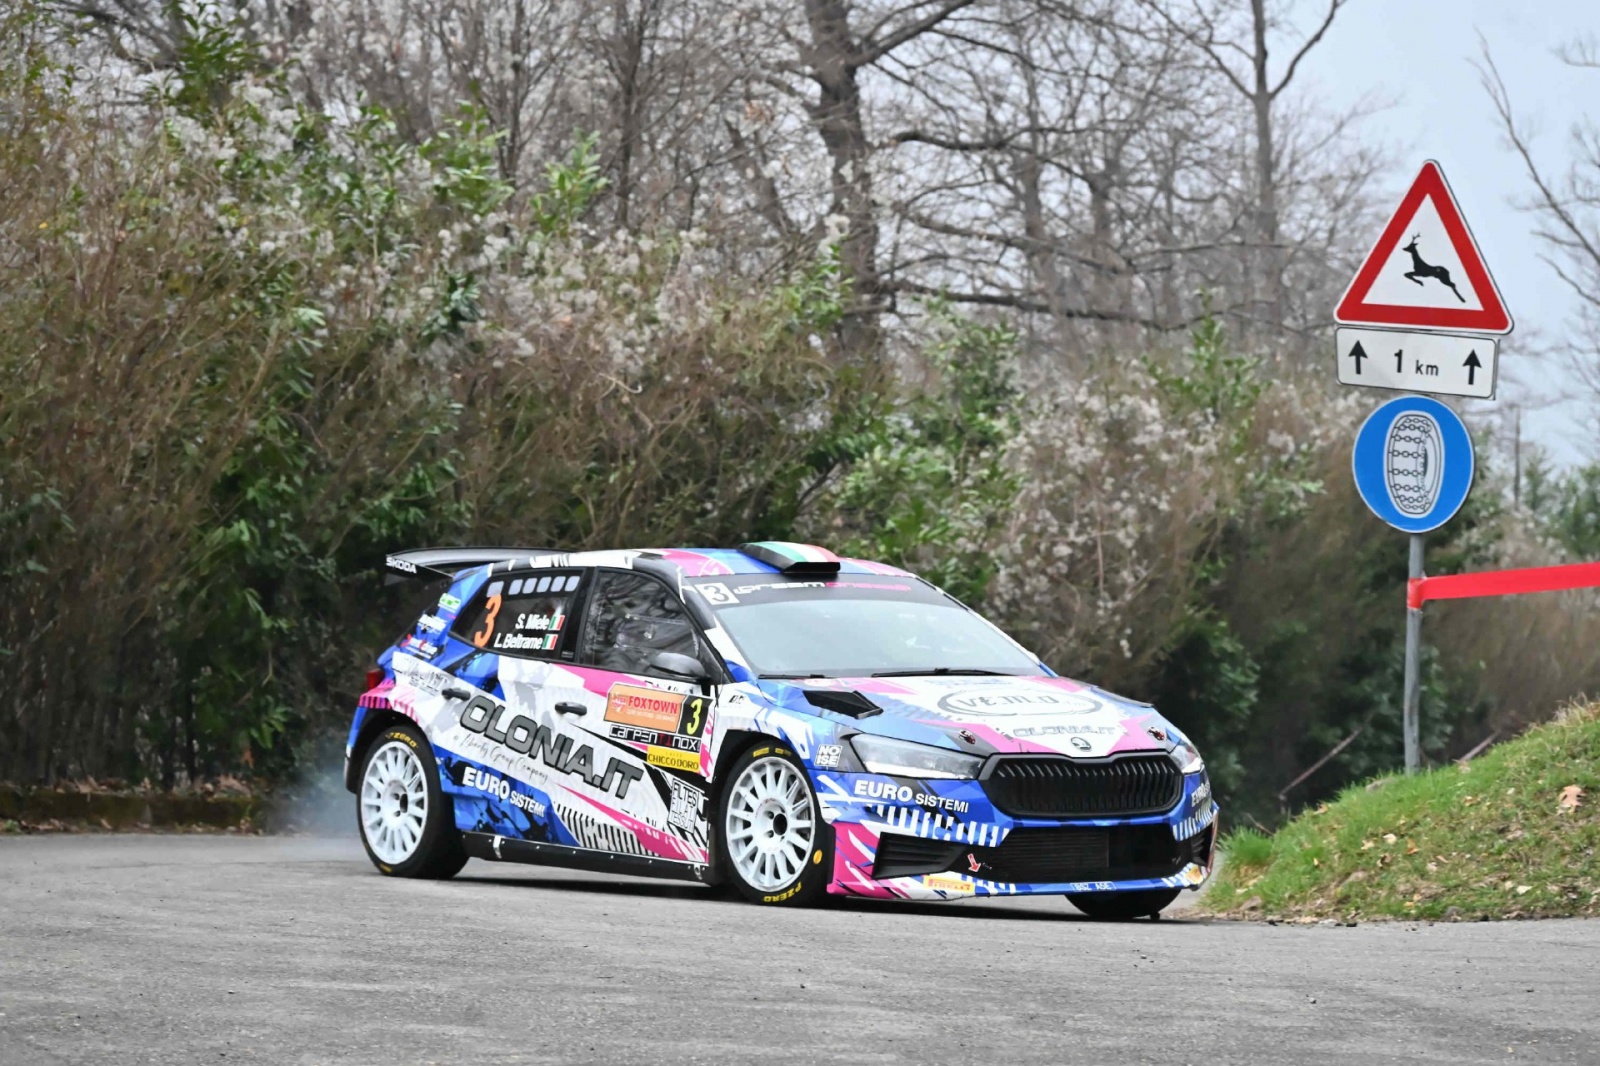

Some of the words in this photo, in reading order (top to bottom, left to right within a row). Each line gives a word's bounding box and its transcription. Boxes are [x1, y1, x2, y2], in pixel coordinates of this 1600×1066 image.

[1394, 349, 1403, 373] 1
[1415, 359, 1439, 376] km
[703, 585, 730, 602] 3
[474, 593, 502, 648] 3
[525, 613, 550, 630] Miele
[502, 633, 544, 649] Beltrame
[628, 695, 678, 714] FOXTOWN
[686, 698, 703, 735] 3
[647, 753, 676, 767] CHICCO
[816, 755, 839, 765] ISE
[819, 745, 841, 756] NO
[514, 757, 549, 785] Company
[462, 766, 510, 800] EURO
[509, 789, 545, 818] SISTEMI
[854, 780, 914, 802] EURO
[915, 793, 969, 814] SISTEMI
